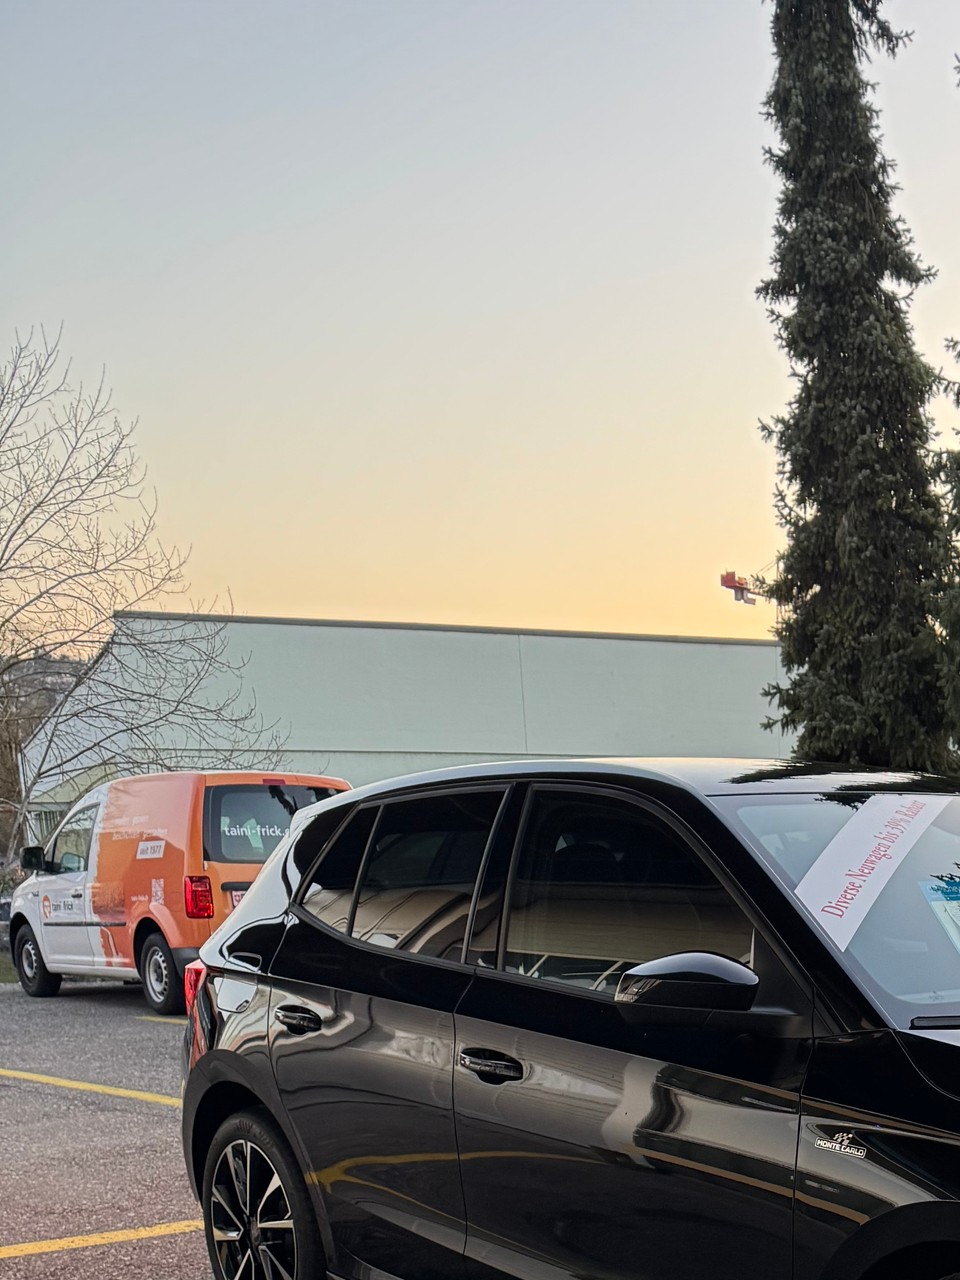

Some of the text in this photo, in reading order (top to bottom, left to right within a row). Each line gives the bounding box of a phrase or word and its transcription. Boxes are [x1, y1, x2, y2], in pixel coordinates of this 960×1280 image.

[224, 825, 290, 836] taini-frick.c
[820, 881, 863, 919] Diverse
[844, 842, 893, 882] Neuwagen
[873, 831, 900, 843] bis
[895, 800, 927, 819] Rabatt
[816, 1139, 865, 1156] MONTE CARLO
